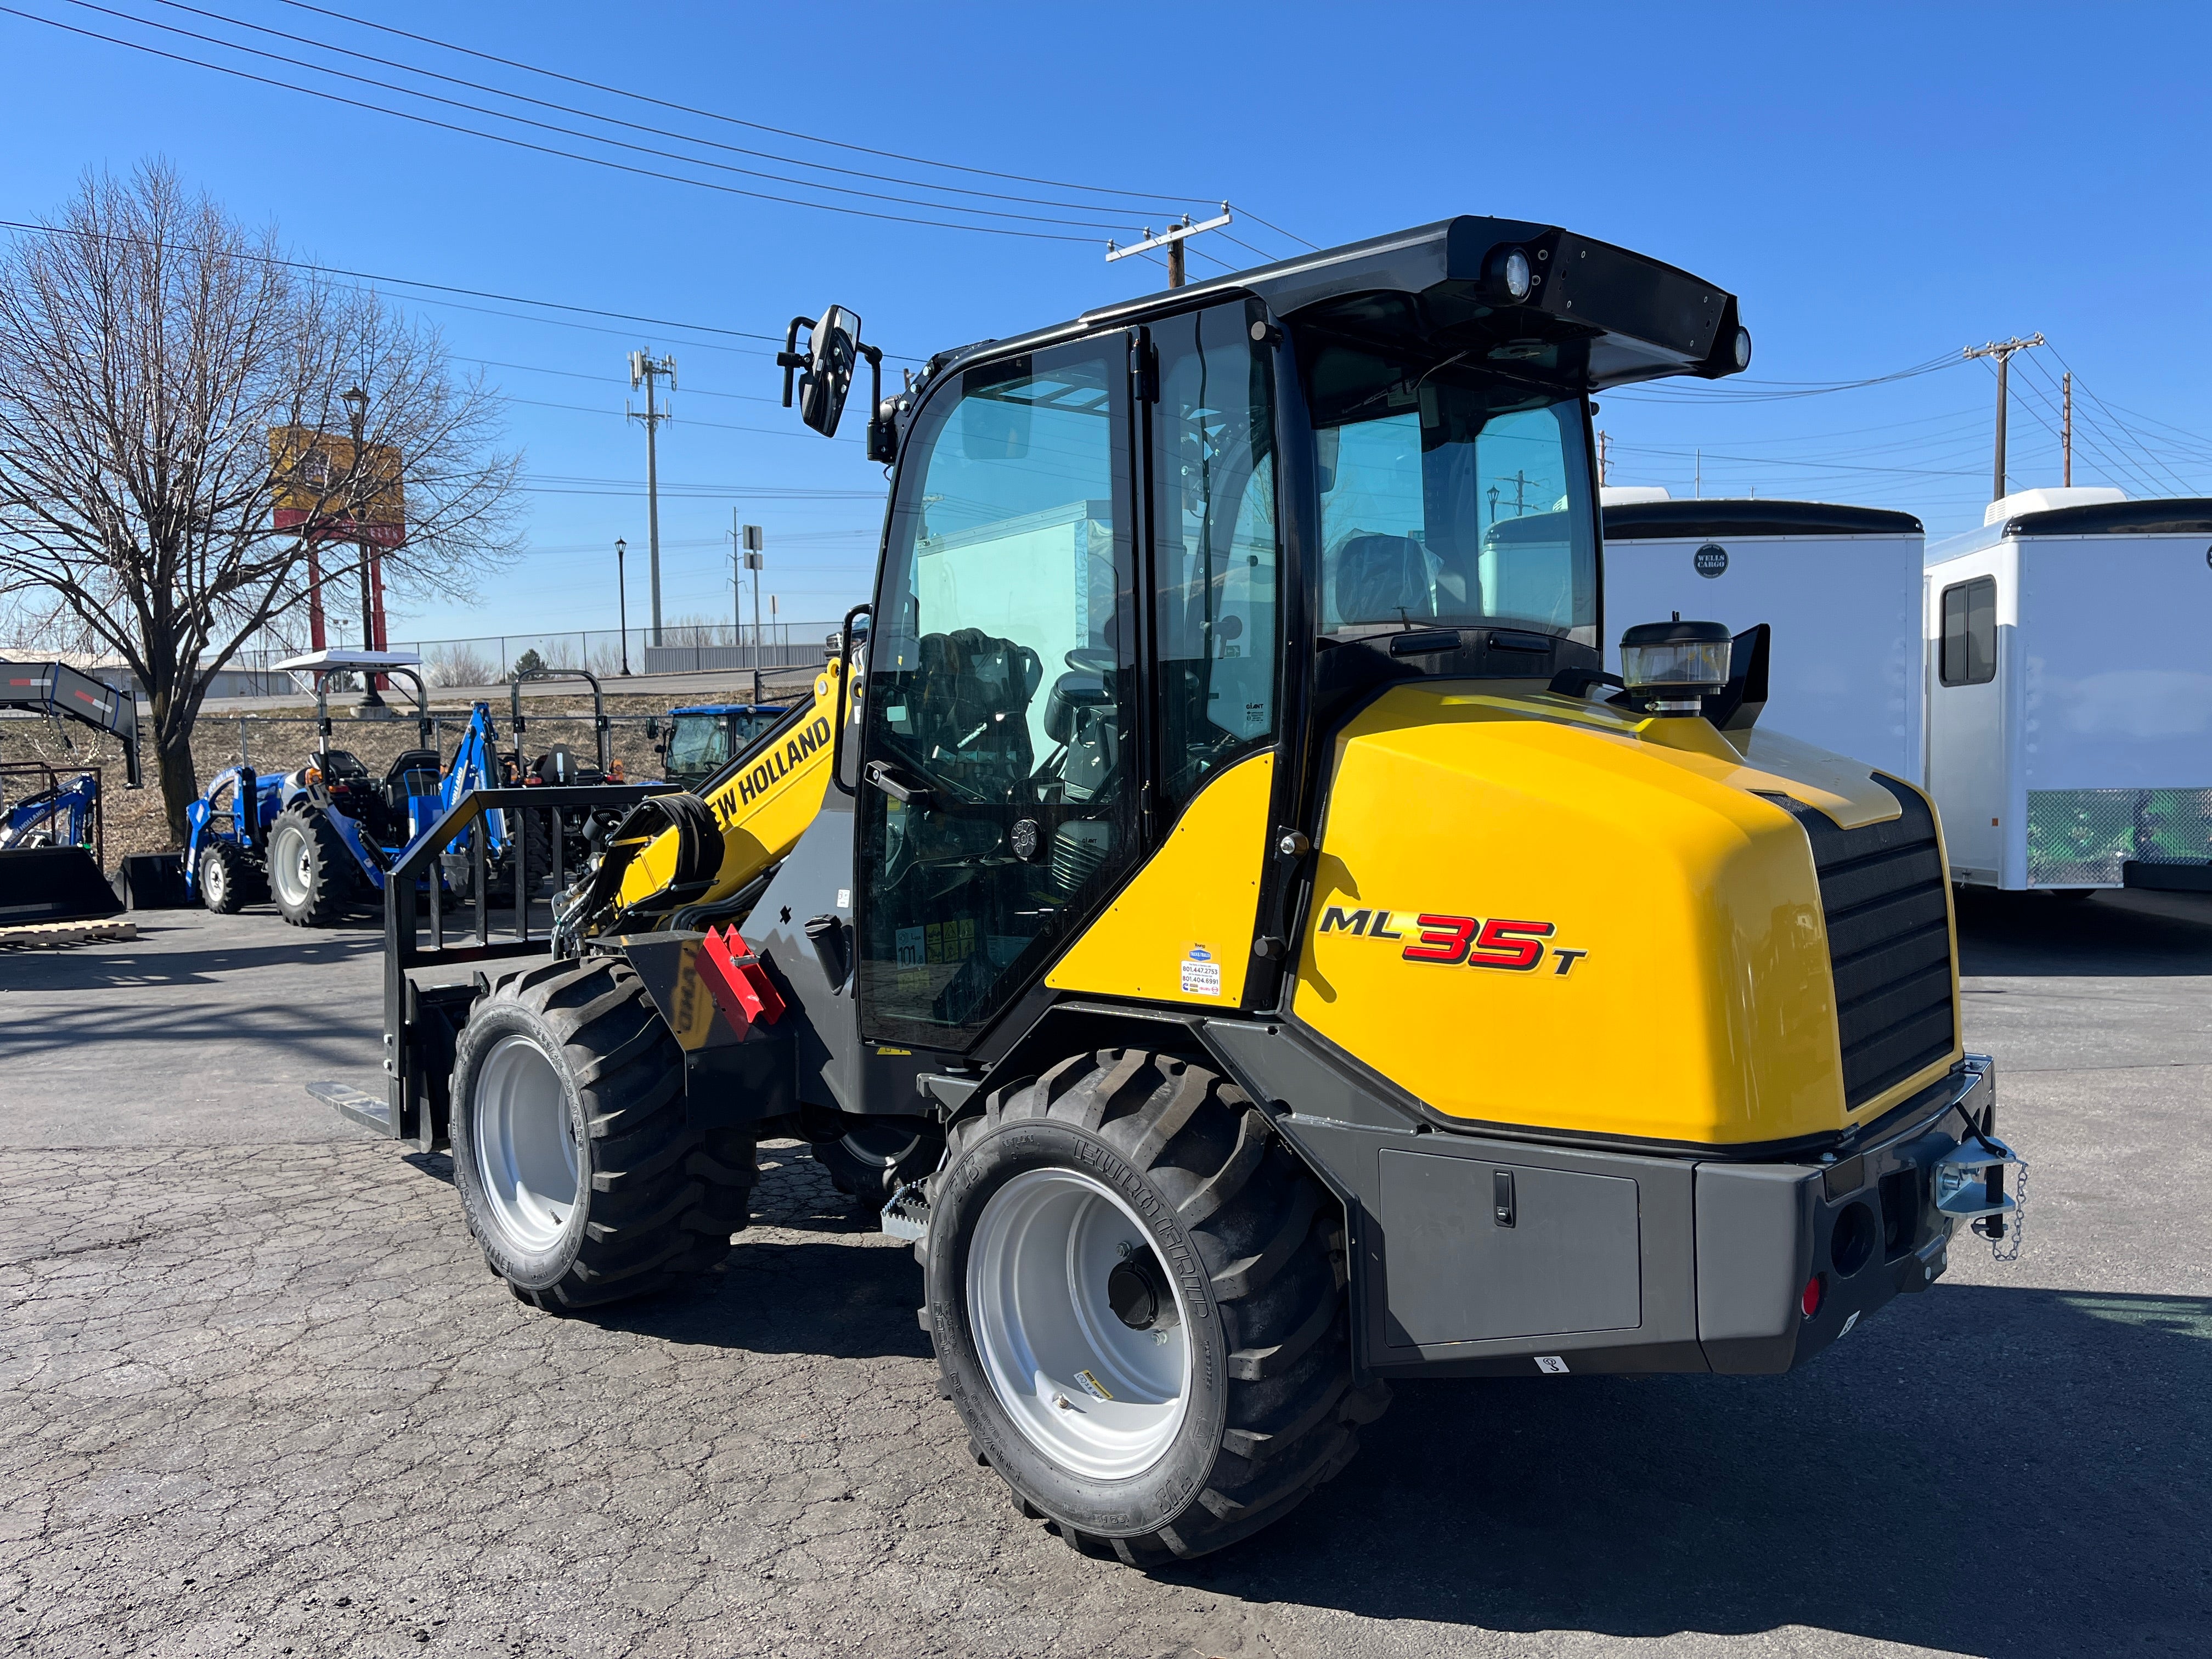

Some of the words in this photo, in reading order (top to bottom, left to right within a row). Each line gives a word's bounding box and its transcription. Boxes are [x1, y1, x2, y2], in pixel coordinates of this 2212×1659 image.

[738, 716, 831, 806] HOLLAND
[19, 808, 46, 831] HOLLAND
[898, 945, 916, 967] 101
[1183, 966, 1218, 975] 801.447.2753
[1183, 975, 1218, 985] 801.404.6991
[1002, 1135, 1035, 1148] NYLON
[944, 1301, 960, 1357] TRACTION
